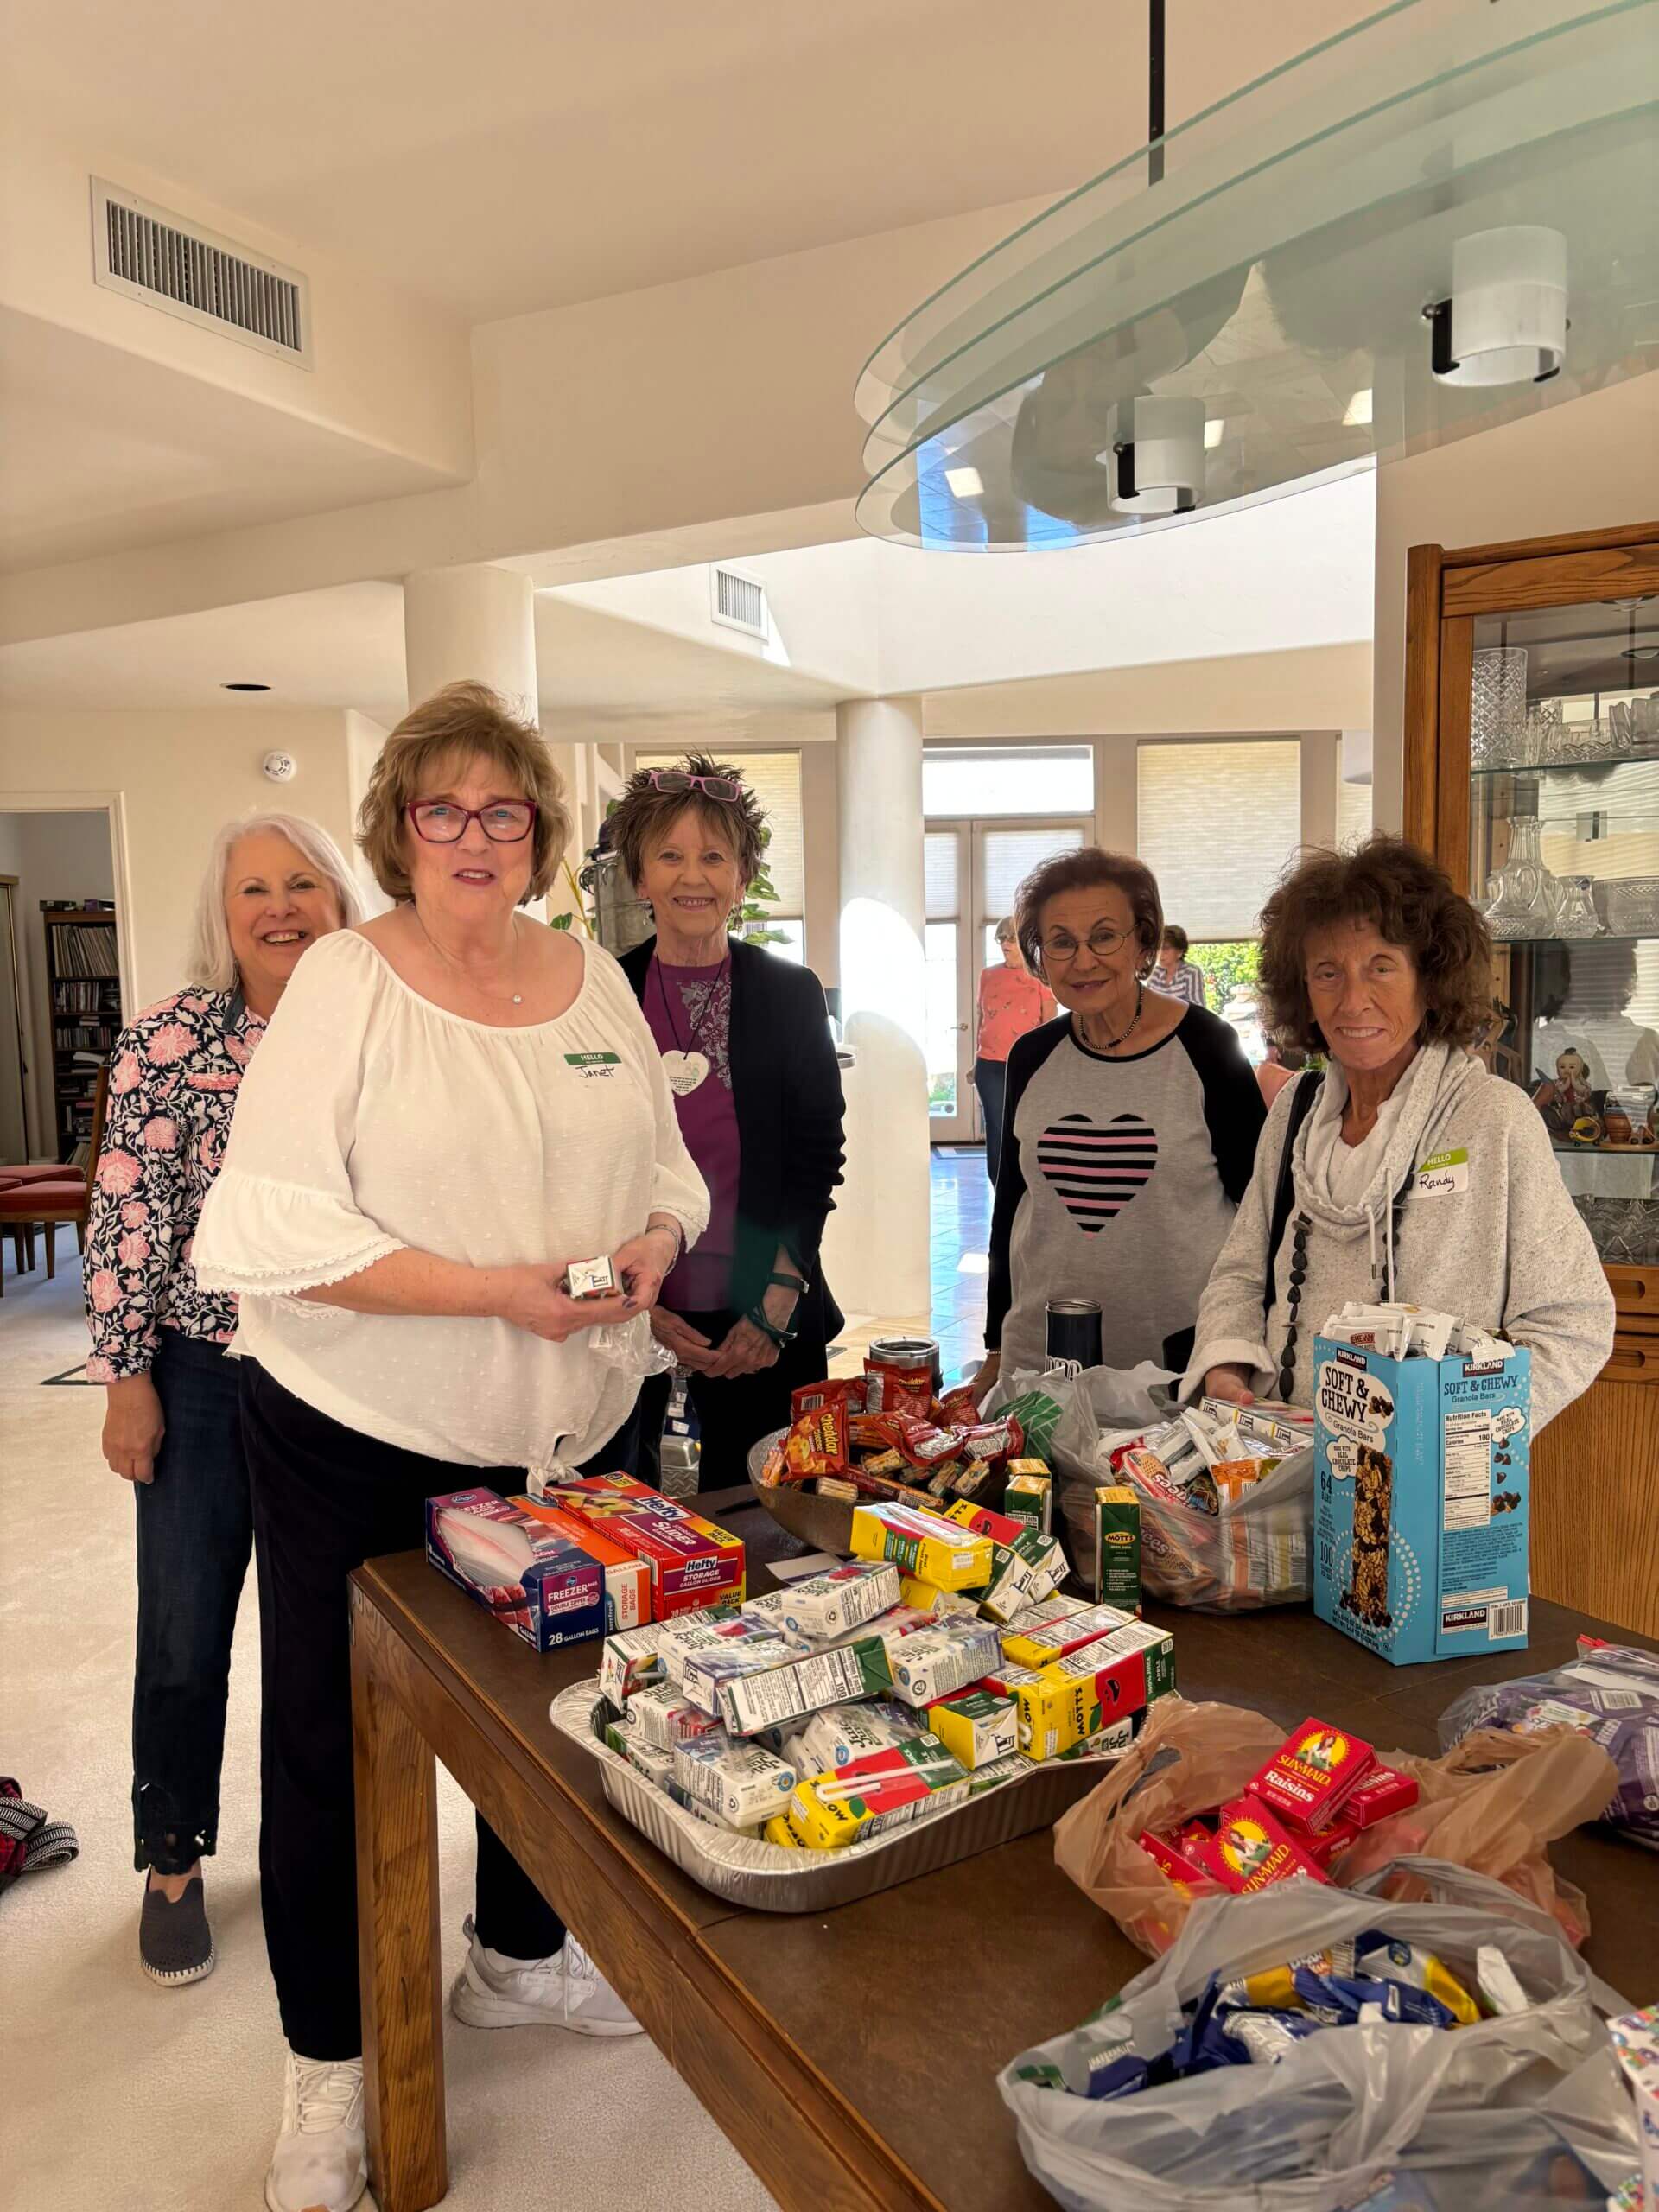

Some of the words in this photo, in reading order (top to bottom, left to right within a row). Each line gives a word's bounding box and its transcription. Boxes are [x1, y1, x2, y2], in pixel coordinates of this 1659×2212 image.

[575, 1065, 615, 1078] Janet
[1427, 1154, 1452, 1166] HELLO
[1419, 1169, 1455, 1192] Randy
[1338, 1349, 1366, 1364] KIRKLAND
[1465, 1361, 1503, 1372] KIRKLAND
[1325, 1366, 1353, 1395] SOFT
[1356, 1378, 1370, 1401] &
[1444, 1381, 1468, 1396] SOFT
[1470, 1380, 1479, 1392] &
[1481, 1375, 1519, 1392] CHEWY
[1321, 1388, 1367, 1423] CHEWY
[1452, 1395, 1478, 1403] Granola
[1445, 1413, 1471, 1421] Nutrition
[821, 1414, 838, 1455] cheddar
[1333, 1420, 1357, 1436] Granola
[1357, 1430, 1374, 1443] Bars
[1320, 1471, 1332, 1494] 64
[640, 1496, 683, 1520] Hefty
[652, 1521, 697, 1546] SLIDER
[706, 1532, 728, 1544] PACK
[1107, 1534, 1134, 1542] MOTT'S
[1320, 1541, 1333, 1567] 100
[687, 1559, 715, 1571] Hefty
[679, 1579, 702, 1588] GALLON
[683, 1569, 720, 1582] STORAGE
[548, 1584, 588, 1603] FREEZER
[720, 1591, 741, 1599] VALUE
[550, 1602, 569, 1611] DOUBLE
[570, 1597, 586, 1606] ZIPPER
[1445, 1609, 1486, 1623] KIRKLAND
[548, 1632, 563, 1646] 28
[563, 1630, 585, 1642] GALLON
[585, 1627, 600, 1636] BAGS
[846, 1647, 856, 1676] Nutrition
[854, 1677, 863, 1693] Facts
[836, 1681, 848, 1700] 100
[1075, 1687, 1084, 1735] MOTT'S
[1263, 1769, 1315, 1802] Raisins
